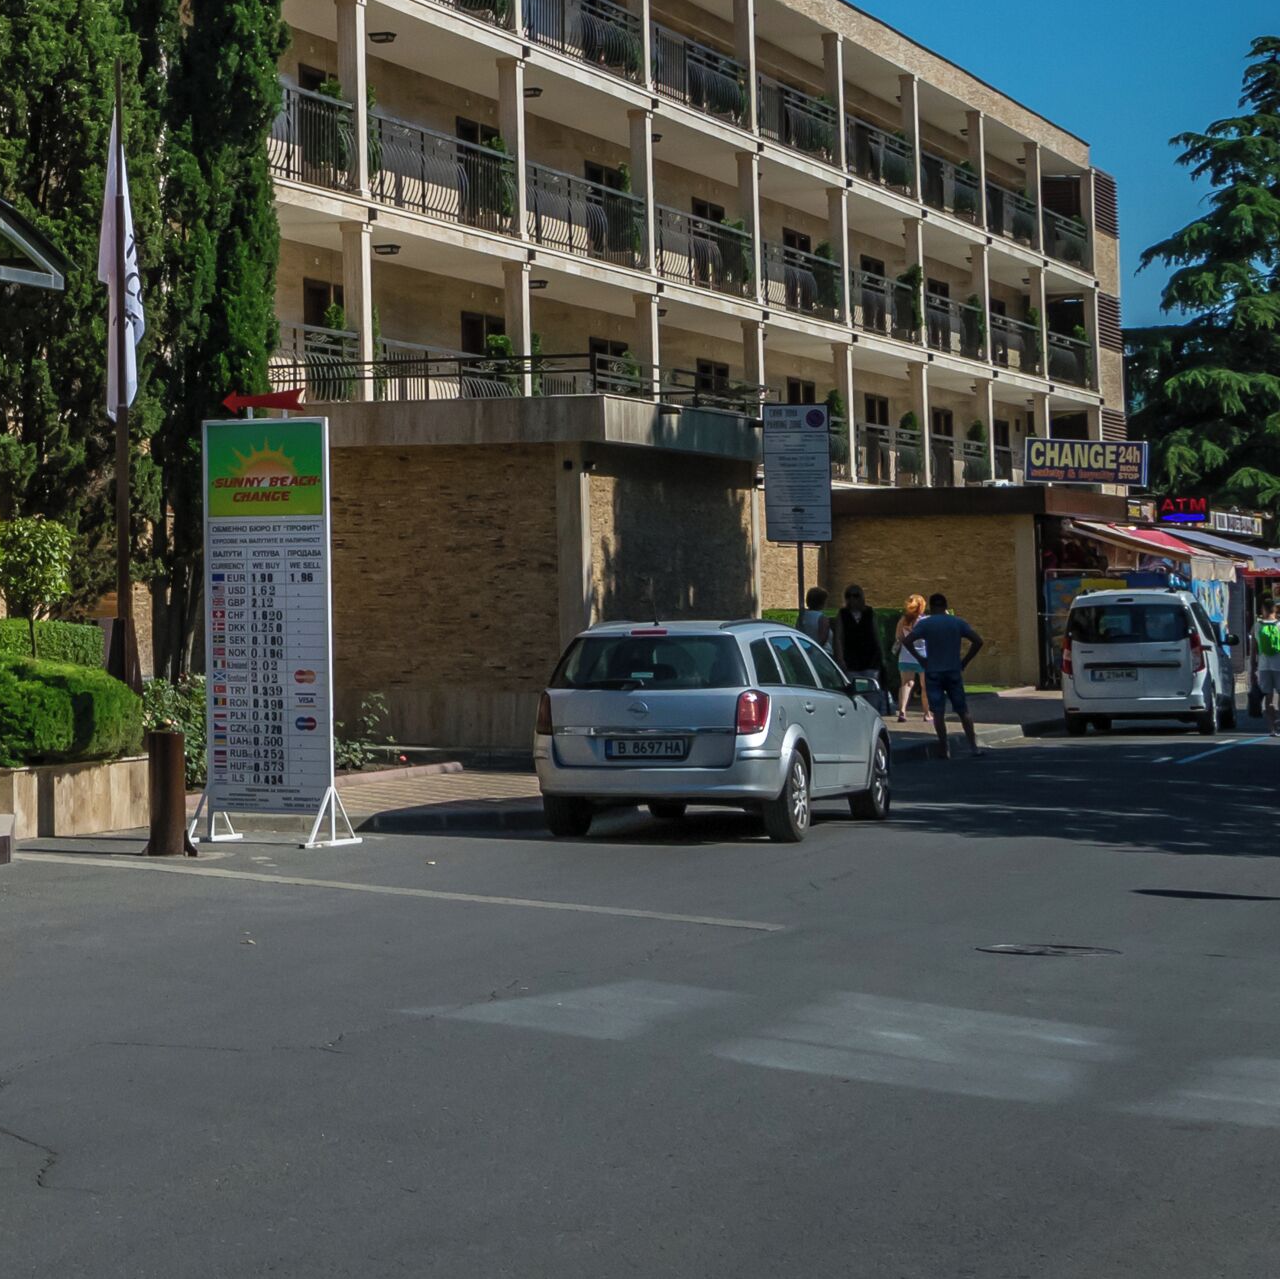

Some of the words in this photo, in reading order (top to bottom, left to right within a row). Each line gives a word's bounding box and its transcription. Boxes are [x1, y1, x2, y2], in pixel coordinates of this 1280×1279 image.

[1030, 441, 1117, 469] CHANGE
[1118, 446, 1140, 463] 24h
[232, 491, 291, 503] CHANGE
[1162, 497, 1207, 511] ATM
[212, 525, 247, 533] ОБМЕННО
[212, 550, 243, 558] ВАЛУТИ
[287, 549, 322, 557] ПРОДАВА
[211, 562, 245, 570] CURRENCY
[303, 561, 321, 569] SELL
[227, 573, 246, 582] EUR
[228, 586, 246, 595] USD
[251, 585, 276, 596] 1.62
[228, 598, 246, 607] GBP
[251, 597, 274, 608] 2.12
[228, 611, 245, 619] CHF
[228, 623, 246, 632] DKK
[229, 636, 246, 644] SEK
[228, 648, 247, 657] NOK
[251, 660, 278, 671] 2.02
[251, 672, 278, 683] 2.02
[230, 686, 247, 694] TRY
[230, 699, 248, 707] RON
[230, 712, 247, 720] PLN
[230, 724, 247, 732] CZK
[230, 737, 248, 745] UAH
[633, 741, 663, 754] 8697
[230, 749, 248, 757] RUB
[230, 762, 247, 770] HUF
[232, 774, 245, 782] ILS
